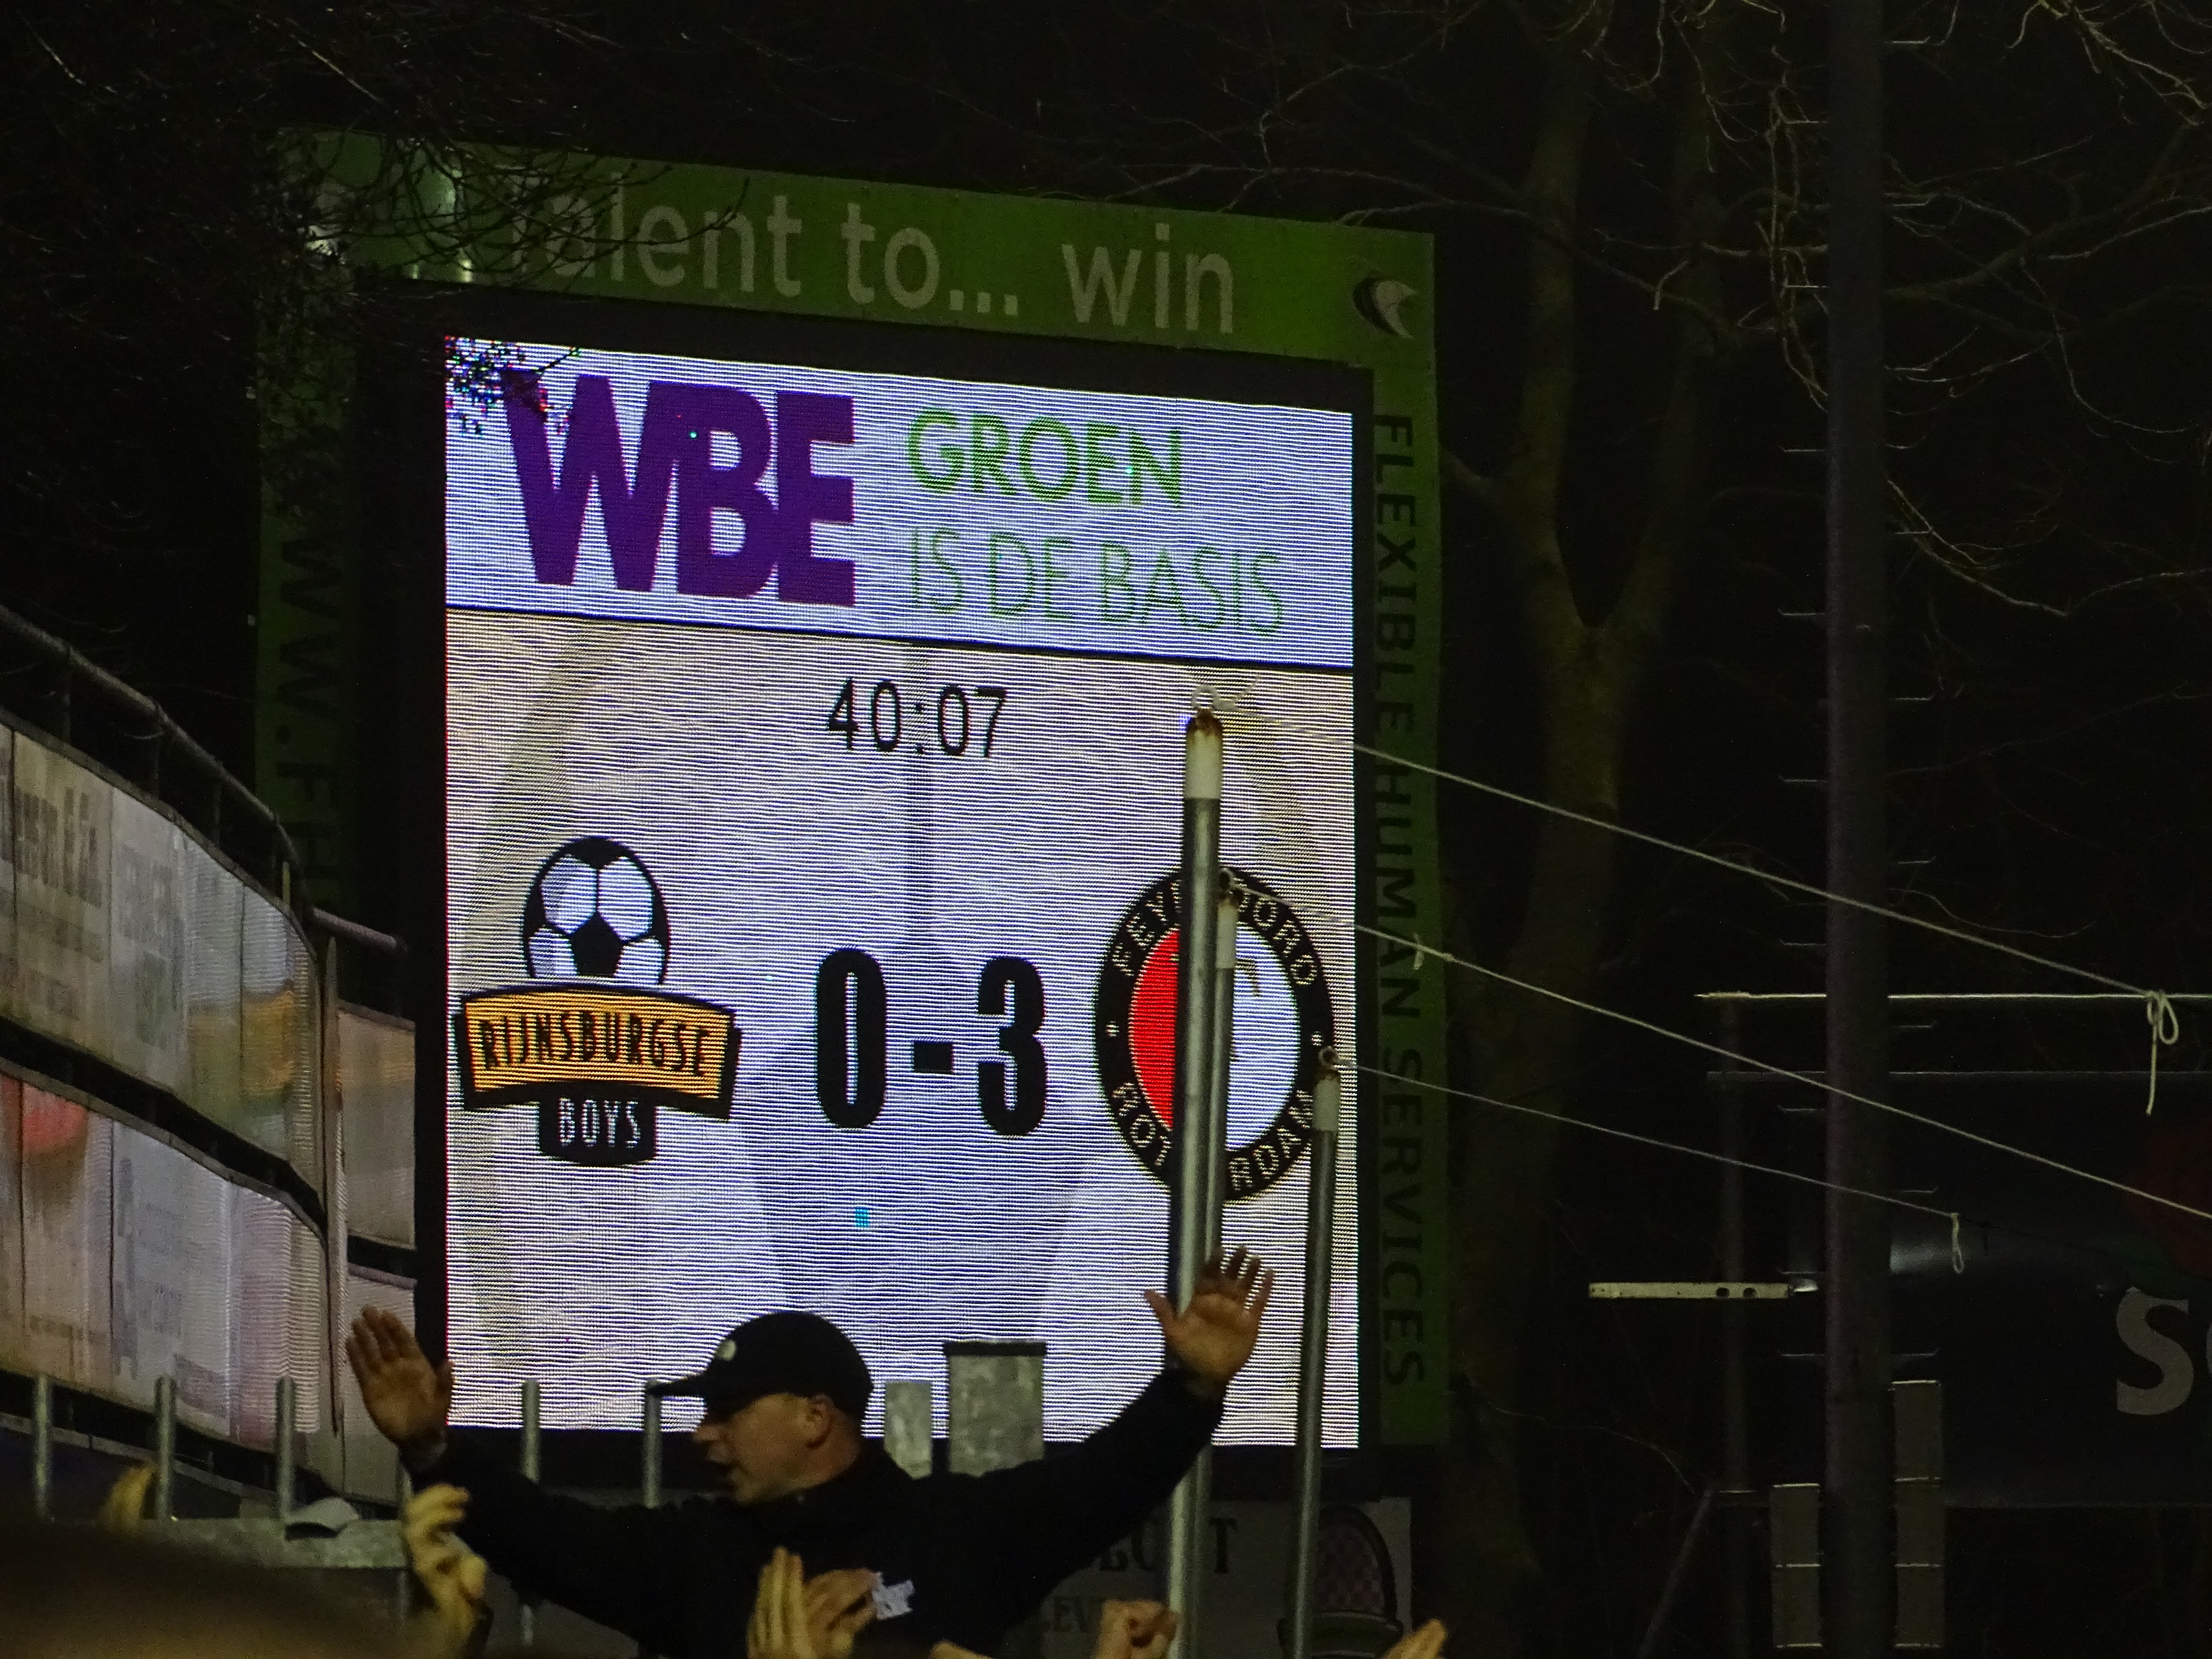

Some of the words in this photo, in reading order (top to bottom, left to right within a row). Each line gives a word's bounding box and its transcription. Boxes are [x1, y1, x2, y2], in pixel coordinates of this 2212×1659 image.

[840, 203, 1019, 316] to...
[1061, 222, 1234, 335] win
[500, 368, 855, 607] WBE
[908, 407, 1183, 509] GROEN
[911, 527, 963, 615] IS
[989, 531, 1074, 620] DE
[1100, 540, 1282, 637] BASIS
[1375, 413, 1417, 735] FLEXIBLE
[827, 677, 1008, 758] 40:07
[1374, 762, 1421, 1019] HUMAN
[479, 1010, 712, 1077] RIJNSBURGSE
[557, 1095, 640, 1149] BOYS
[1382, 1047, 1425, 1387] SERVICES
[2115, 1284, 2212, 1416] S
